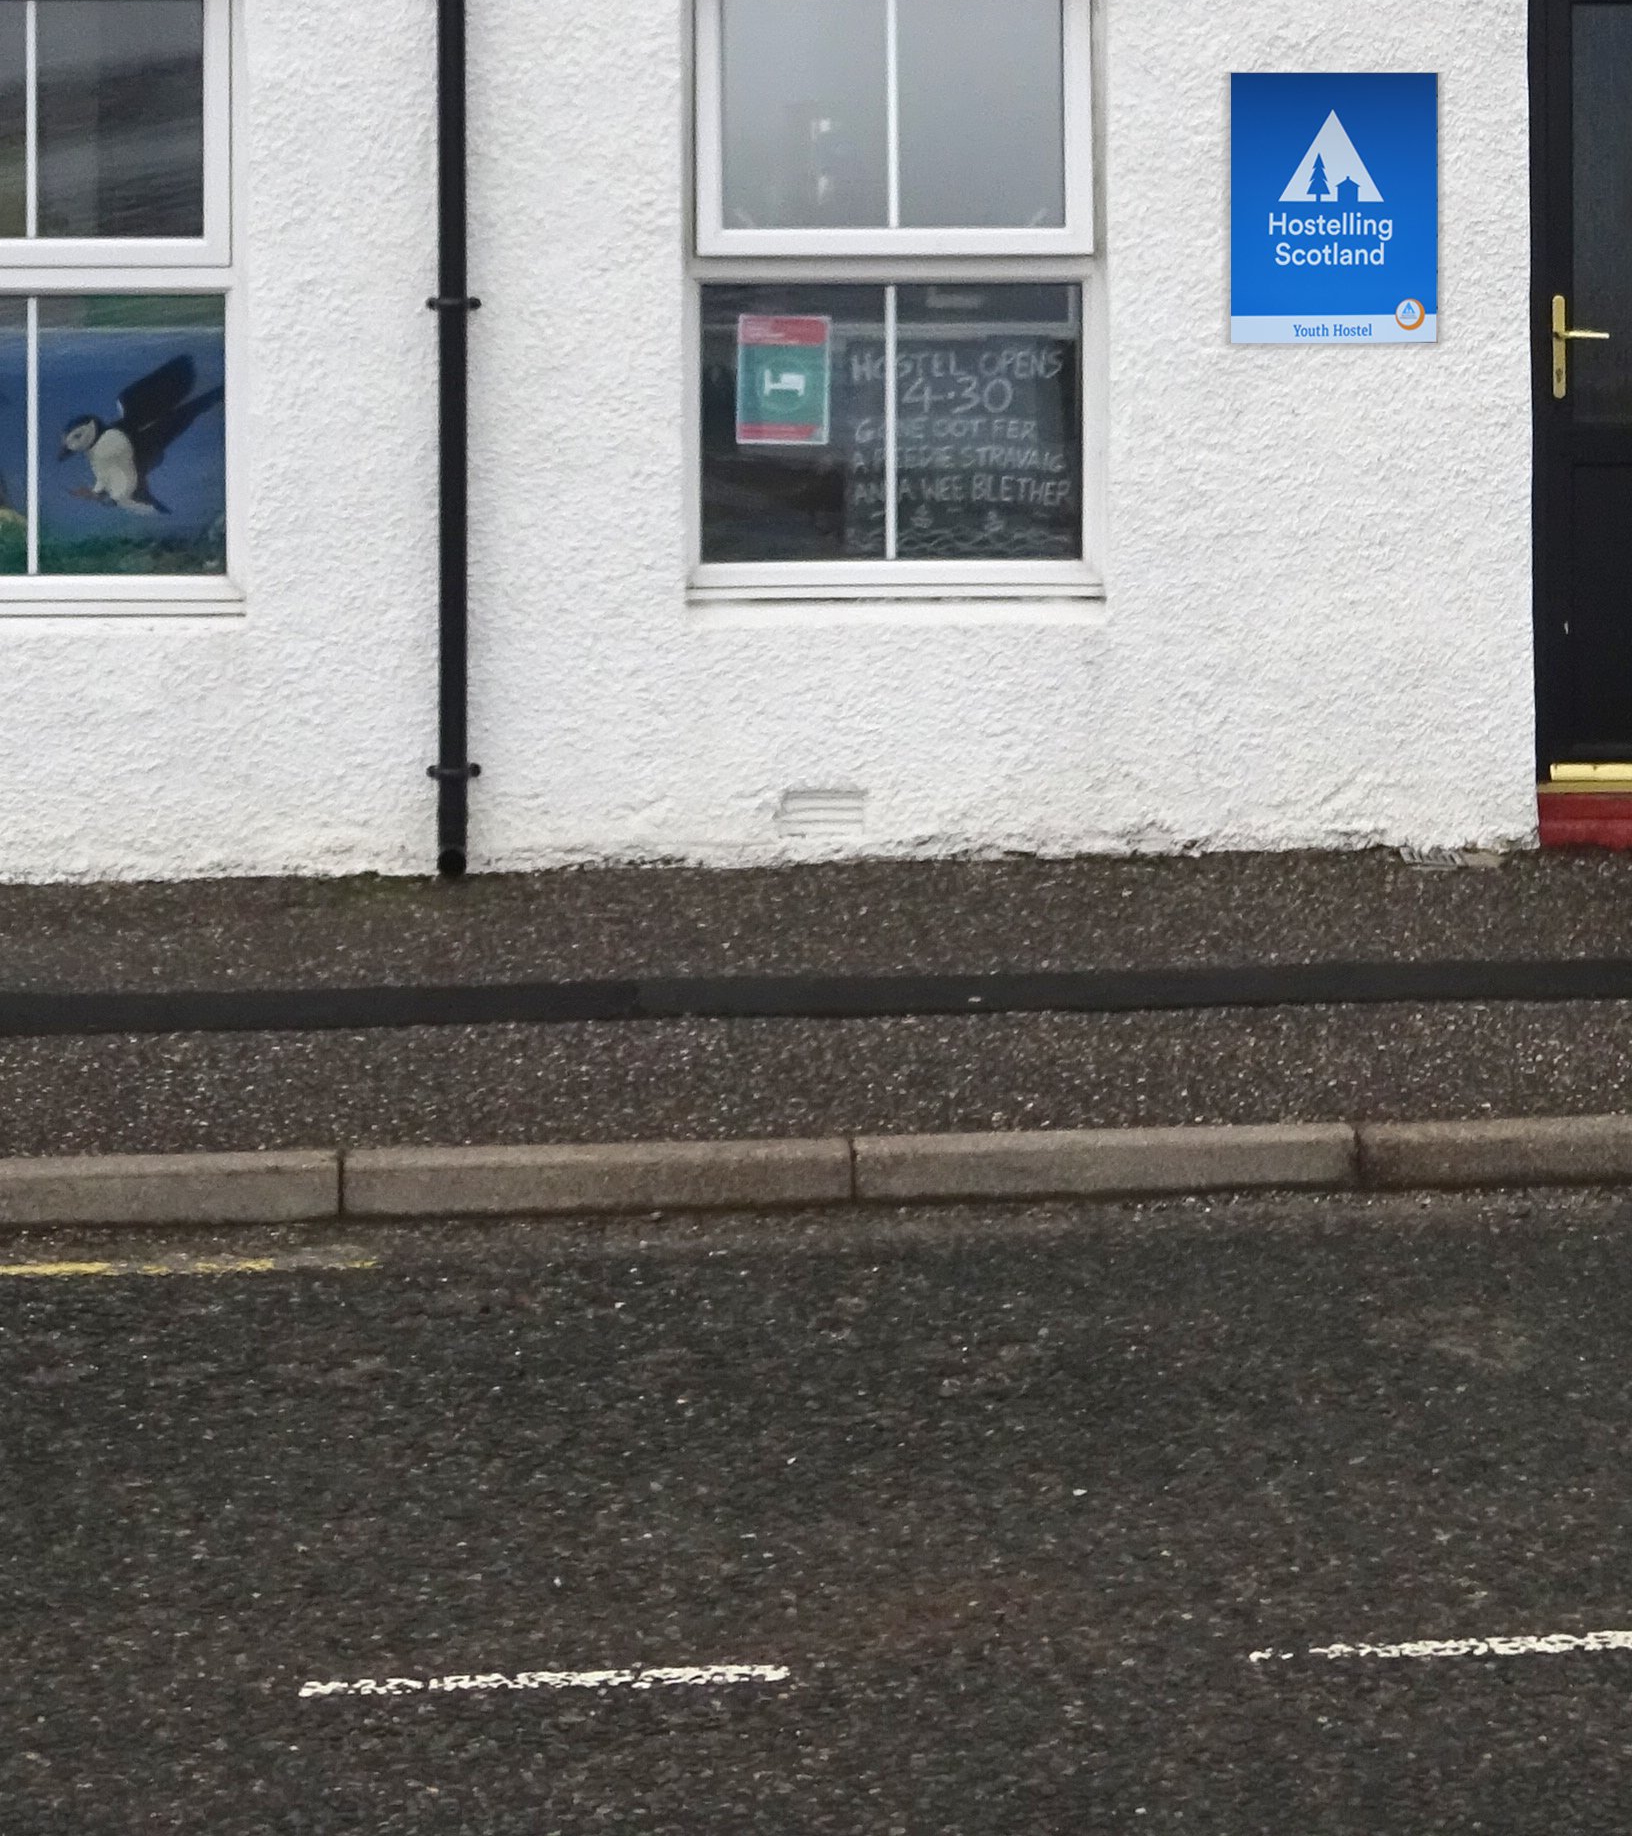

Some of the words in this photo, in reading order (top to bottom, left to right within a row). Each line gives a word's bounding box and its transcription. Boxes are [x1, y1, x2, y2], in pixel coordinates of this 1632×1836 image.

[1268, 212, 1393, 241] Hostelling
[1275, 242, 1385, 266] Scotland
[1293, 324, 1330, 337] Youth
[1333, 323, 1373, 337] Hostel
[979, 348, 1064, 379] OPENS
[921, 475, 965, 502] WEE
